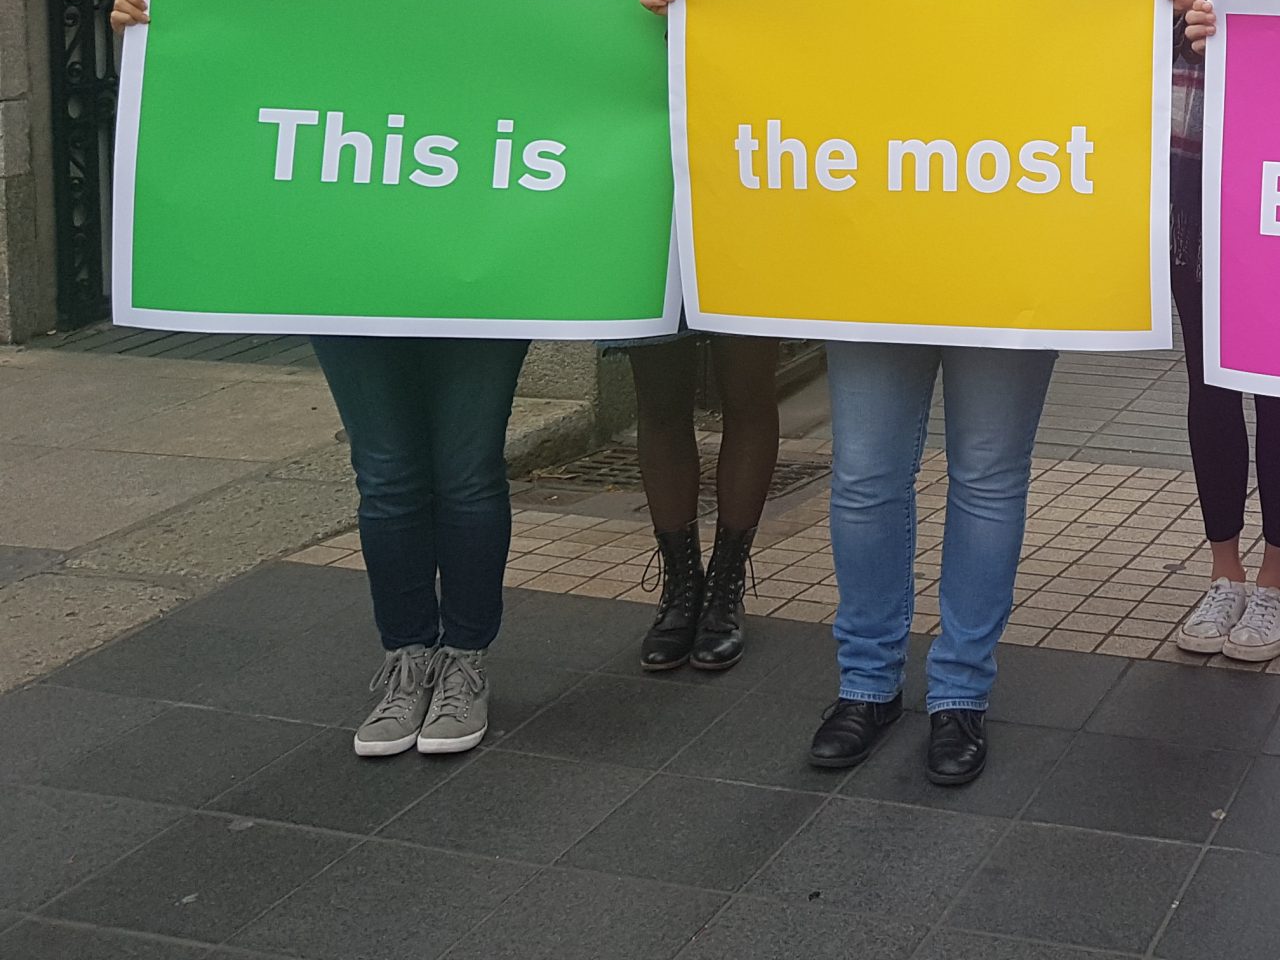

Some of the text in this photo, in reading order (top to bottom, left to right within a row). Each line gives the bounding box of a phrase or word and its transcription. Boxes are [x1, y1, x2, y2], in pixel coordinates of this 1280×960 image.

[258, 107, 567, 192] This is
[734, 119, 1095, 195] the most
